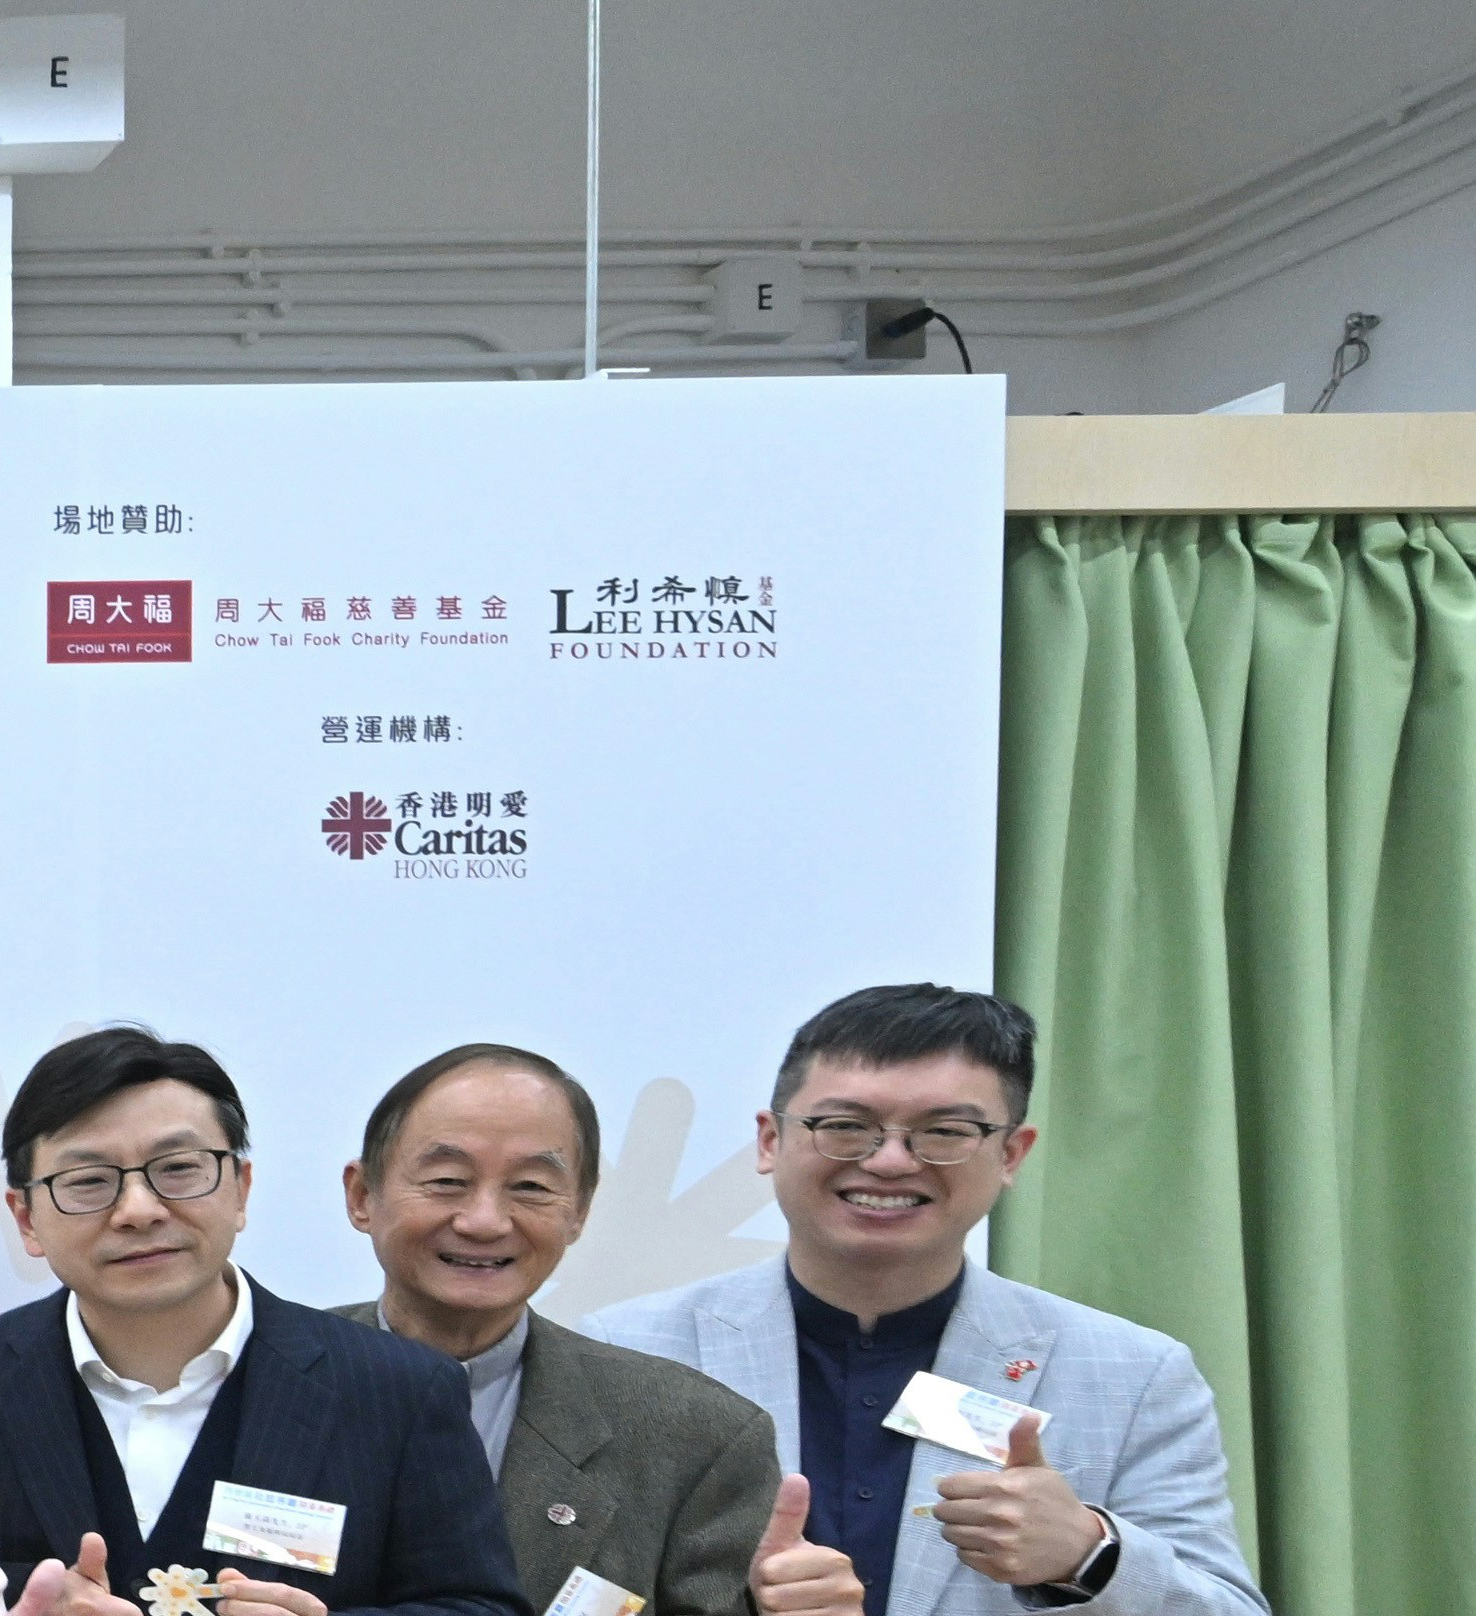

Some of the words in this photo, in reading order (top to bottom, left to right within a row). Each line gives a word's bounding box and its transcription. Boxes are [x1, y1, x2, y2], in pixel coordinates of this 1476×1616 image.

[51, 57, 69, 87] E
[758, 284, 772, 310] E
[68, 595, 171, 624] 周大福
[216, 595, 507, 622] 周大福慈善基金
[654, 610, 776, 633] HYSAN
[67, 644, 104, 653] CHOW
[110, 643, 130, 653] TAI
[136, 643, 171, 652] FOOK
[215, 634, 259, 646] Chow
[270, 633, 292, 646] Tai
[304, 633, 340, 645] Fook
[352, 633, 409, 648] Charity
[421, 632, 508, 644] Foundation
[551, 642, 776, 659] FOUNDATION
[399, 791, 527, 818] 香港明愛
[395, 820, 526, 856] Caritas
[395, 860, 458, 878] HONG
[466, 859, 526, 878] KONG
